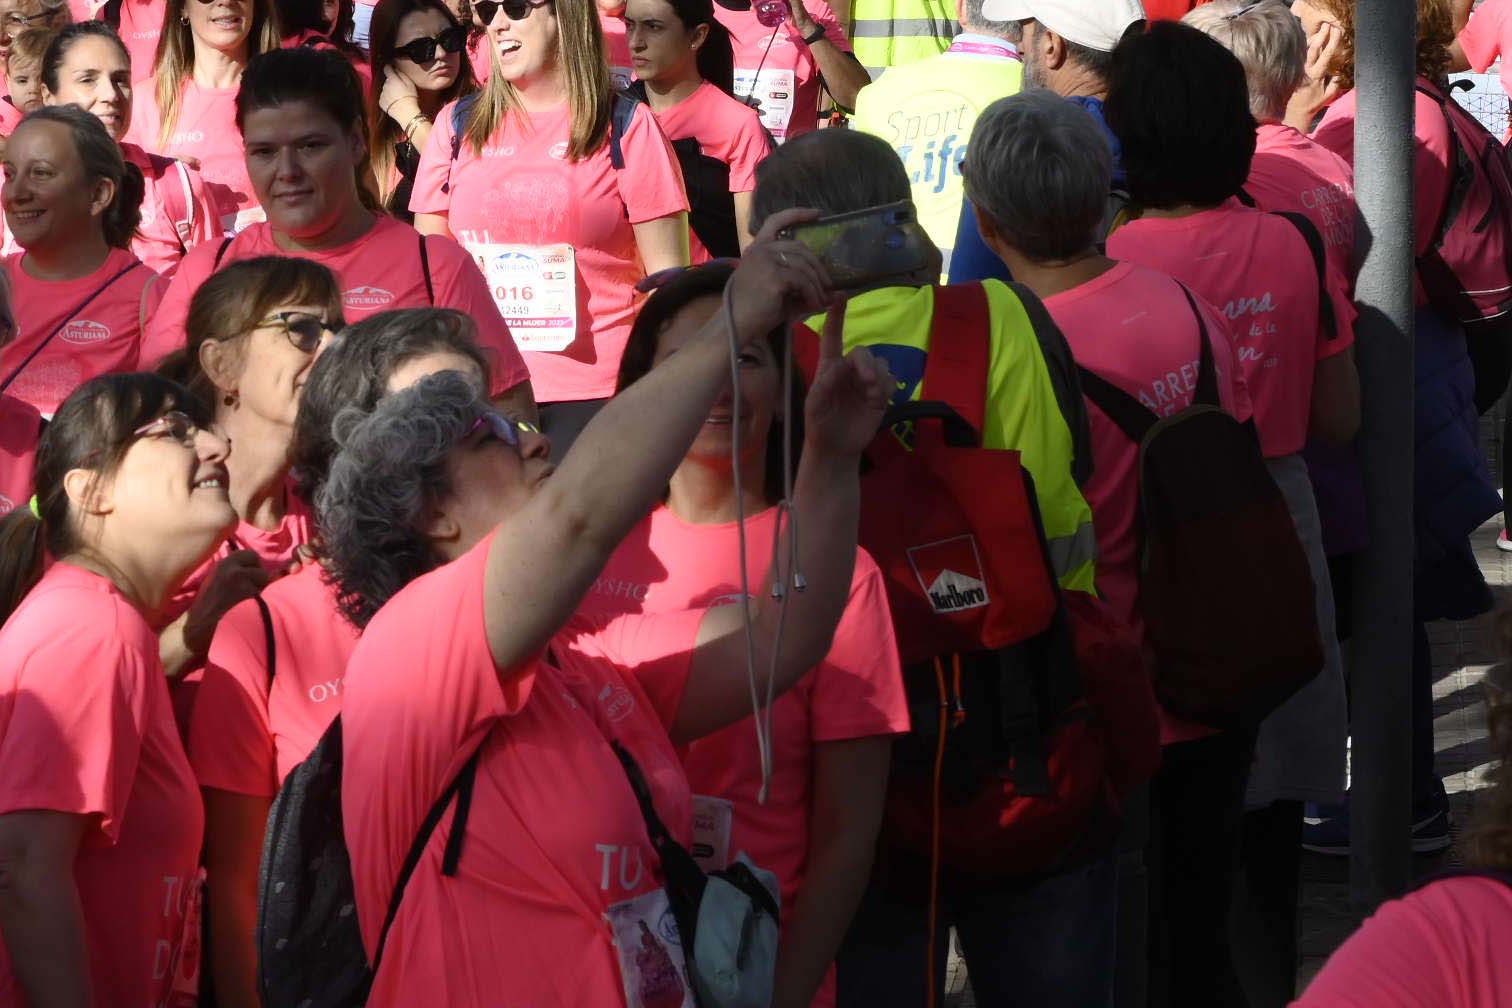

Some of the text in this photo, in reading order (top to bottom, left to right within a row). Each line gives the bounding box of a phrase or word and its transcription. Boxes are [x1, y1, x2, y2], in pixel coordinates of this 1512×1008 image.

[887, 103, 969, 144] Sport
[495, 286, 534, 301] 016
[63, 327, 108, 339] ASTURIANA
[930, 582, 986, 611] Marlboro
[595, 843, 644, 891] TU
